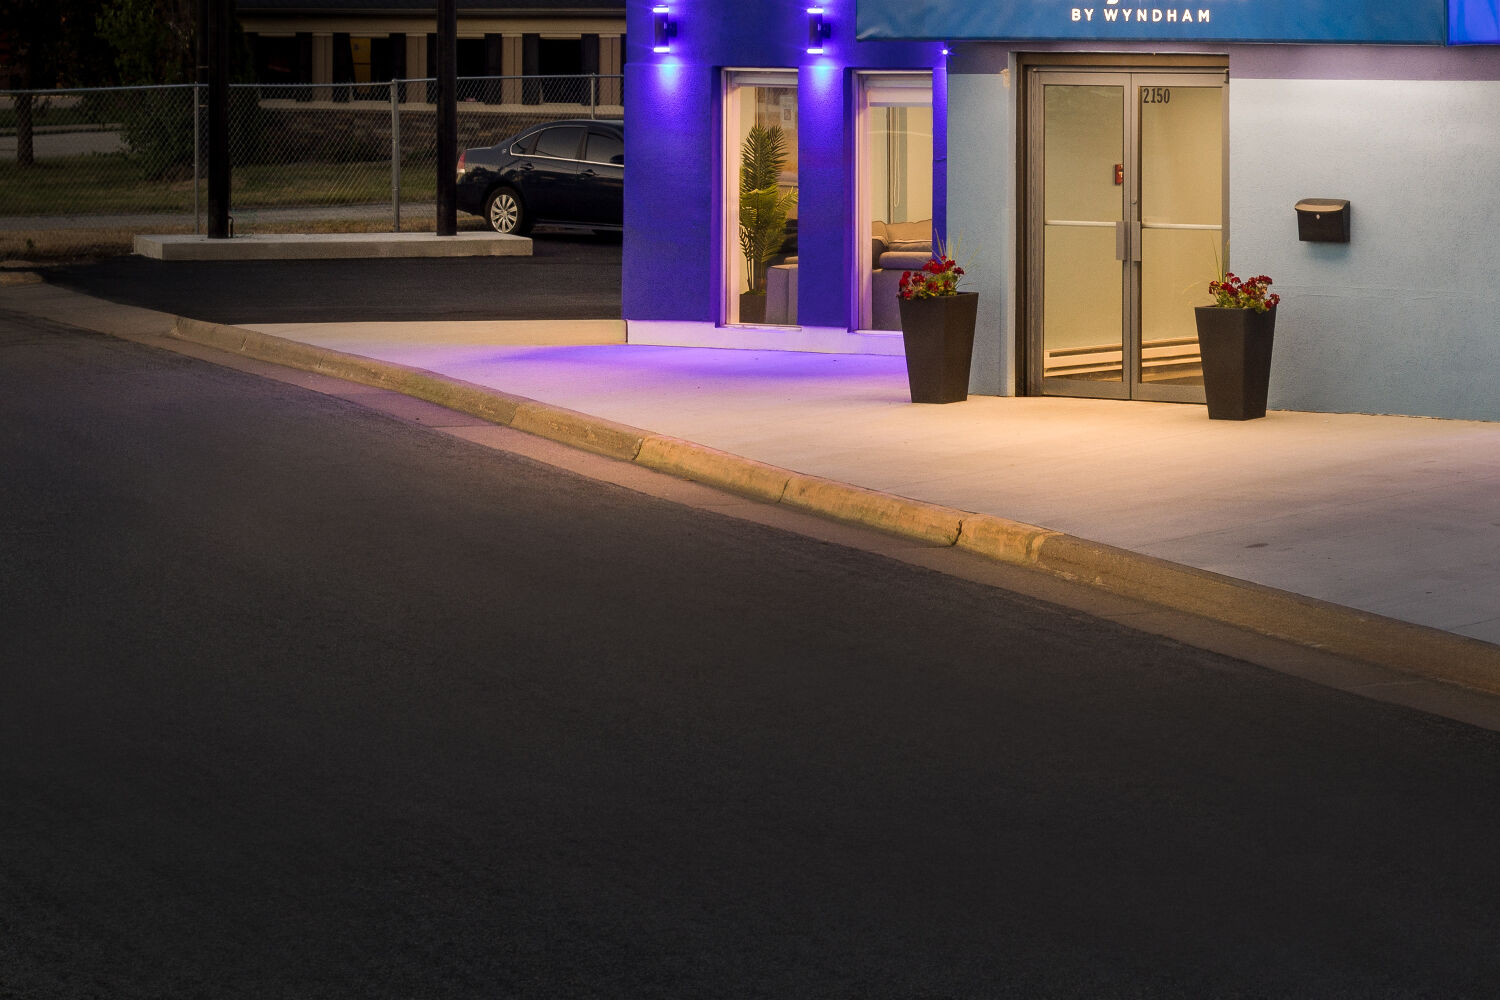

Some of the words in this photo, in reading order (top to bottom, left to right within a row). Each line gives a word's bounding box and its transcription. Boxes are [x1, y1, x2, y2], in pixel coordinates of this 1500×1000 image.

[1071, 8, 1095, 22] BY
[1103, 8, 1211, 23] WYNDHAM
[1142, 87, 1171, 104] 2150
